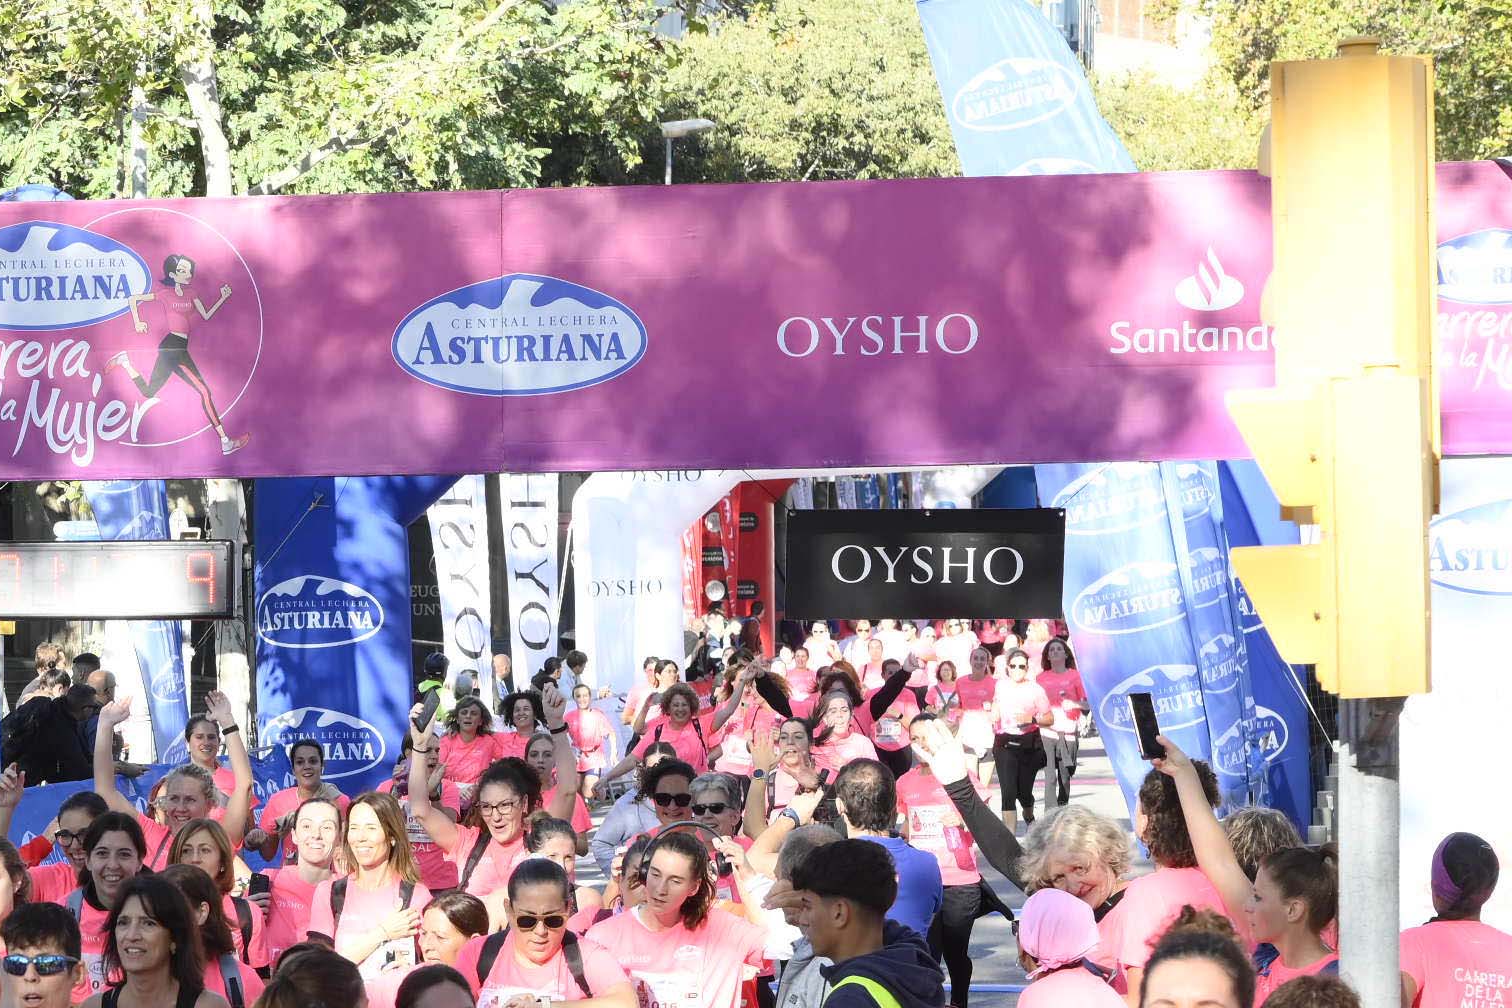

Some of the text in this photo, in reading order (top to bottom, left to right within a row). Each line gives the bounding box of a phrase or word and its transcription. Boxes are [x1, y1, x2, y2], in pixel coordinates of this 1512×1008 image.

[55, 257, 127, 269] LECHERA
[451, 313, 619, 329] CENTRAL LECHERA
[412, 322, 627, 366] ASTURIANA
[777, 313, 979, 357] OYSHO
[1110, 322, 1274, 353] Santand
[12, 369, 160, 467] Mujer
[511, 475, 551, 651] OYSH
[832, 544, 1025, 585] OYSHO
[588, 577, 662, 599] OYSHO
[274, 599, 370, 608] CENTRAL LECHERA
[262, 607, 375, 633] ASTURIANA
[321, 731, 371, 739] LECHERA
[1465, 983, 1503, 1002] DE LA
